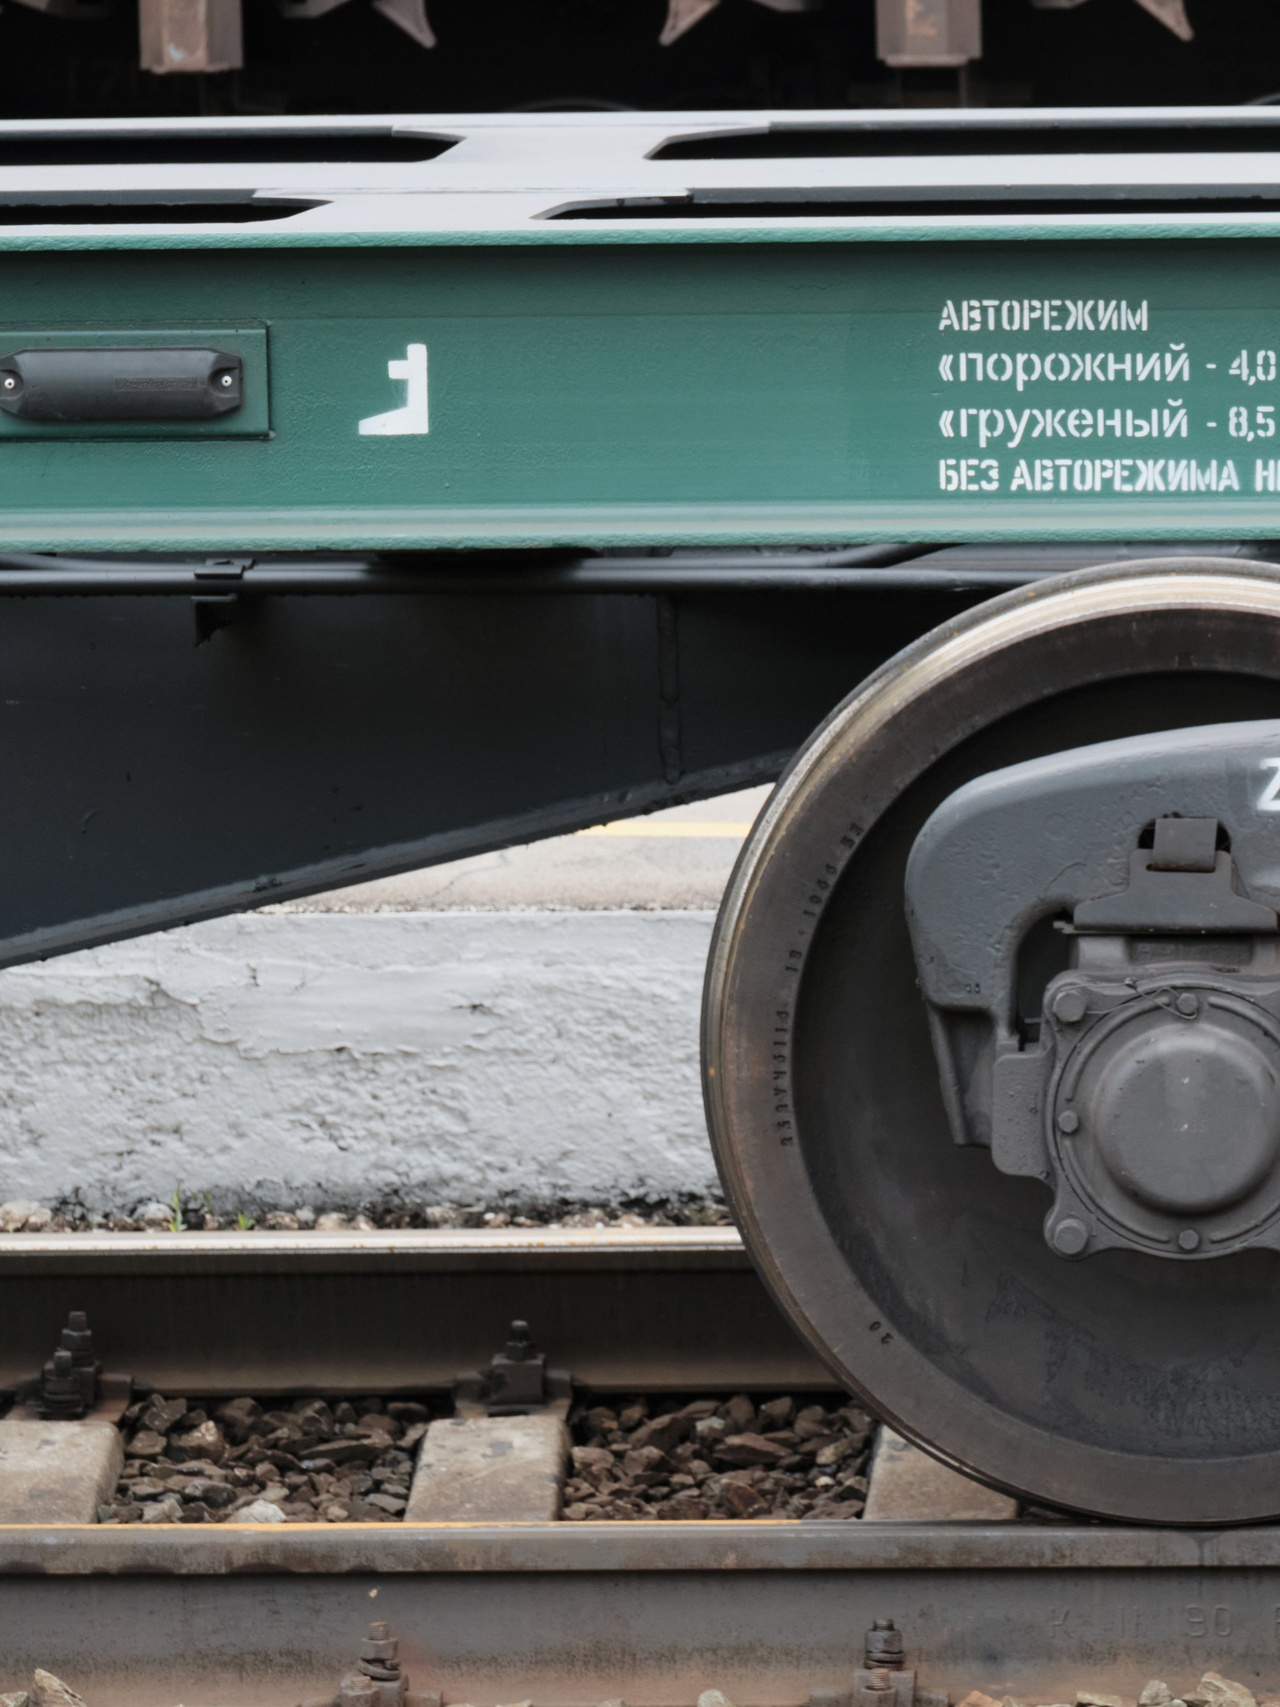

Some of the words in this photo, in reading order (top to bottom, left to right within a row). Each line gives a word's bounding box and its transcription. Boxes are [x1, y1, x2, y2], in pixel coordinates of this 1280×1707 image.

[938, 299, 1148, 332] АВТОРЕЖИМ
[938, 342, 1190, 392] «порожний
[1228, 349, 1277, 386] 4,0
[938, 398, 1188, 449] «груженый
[1228, 405, 1276, 442] 8,5
[938, 458, 1000, 492] БЕЗ
[1009, 458, 1241, 492] АВТОРЕЖИМА
